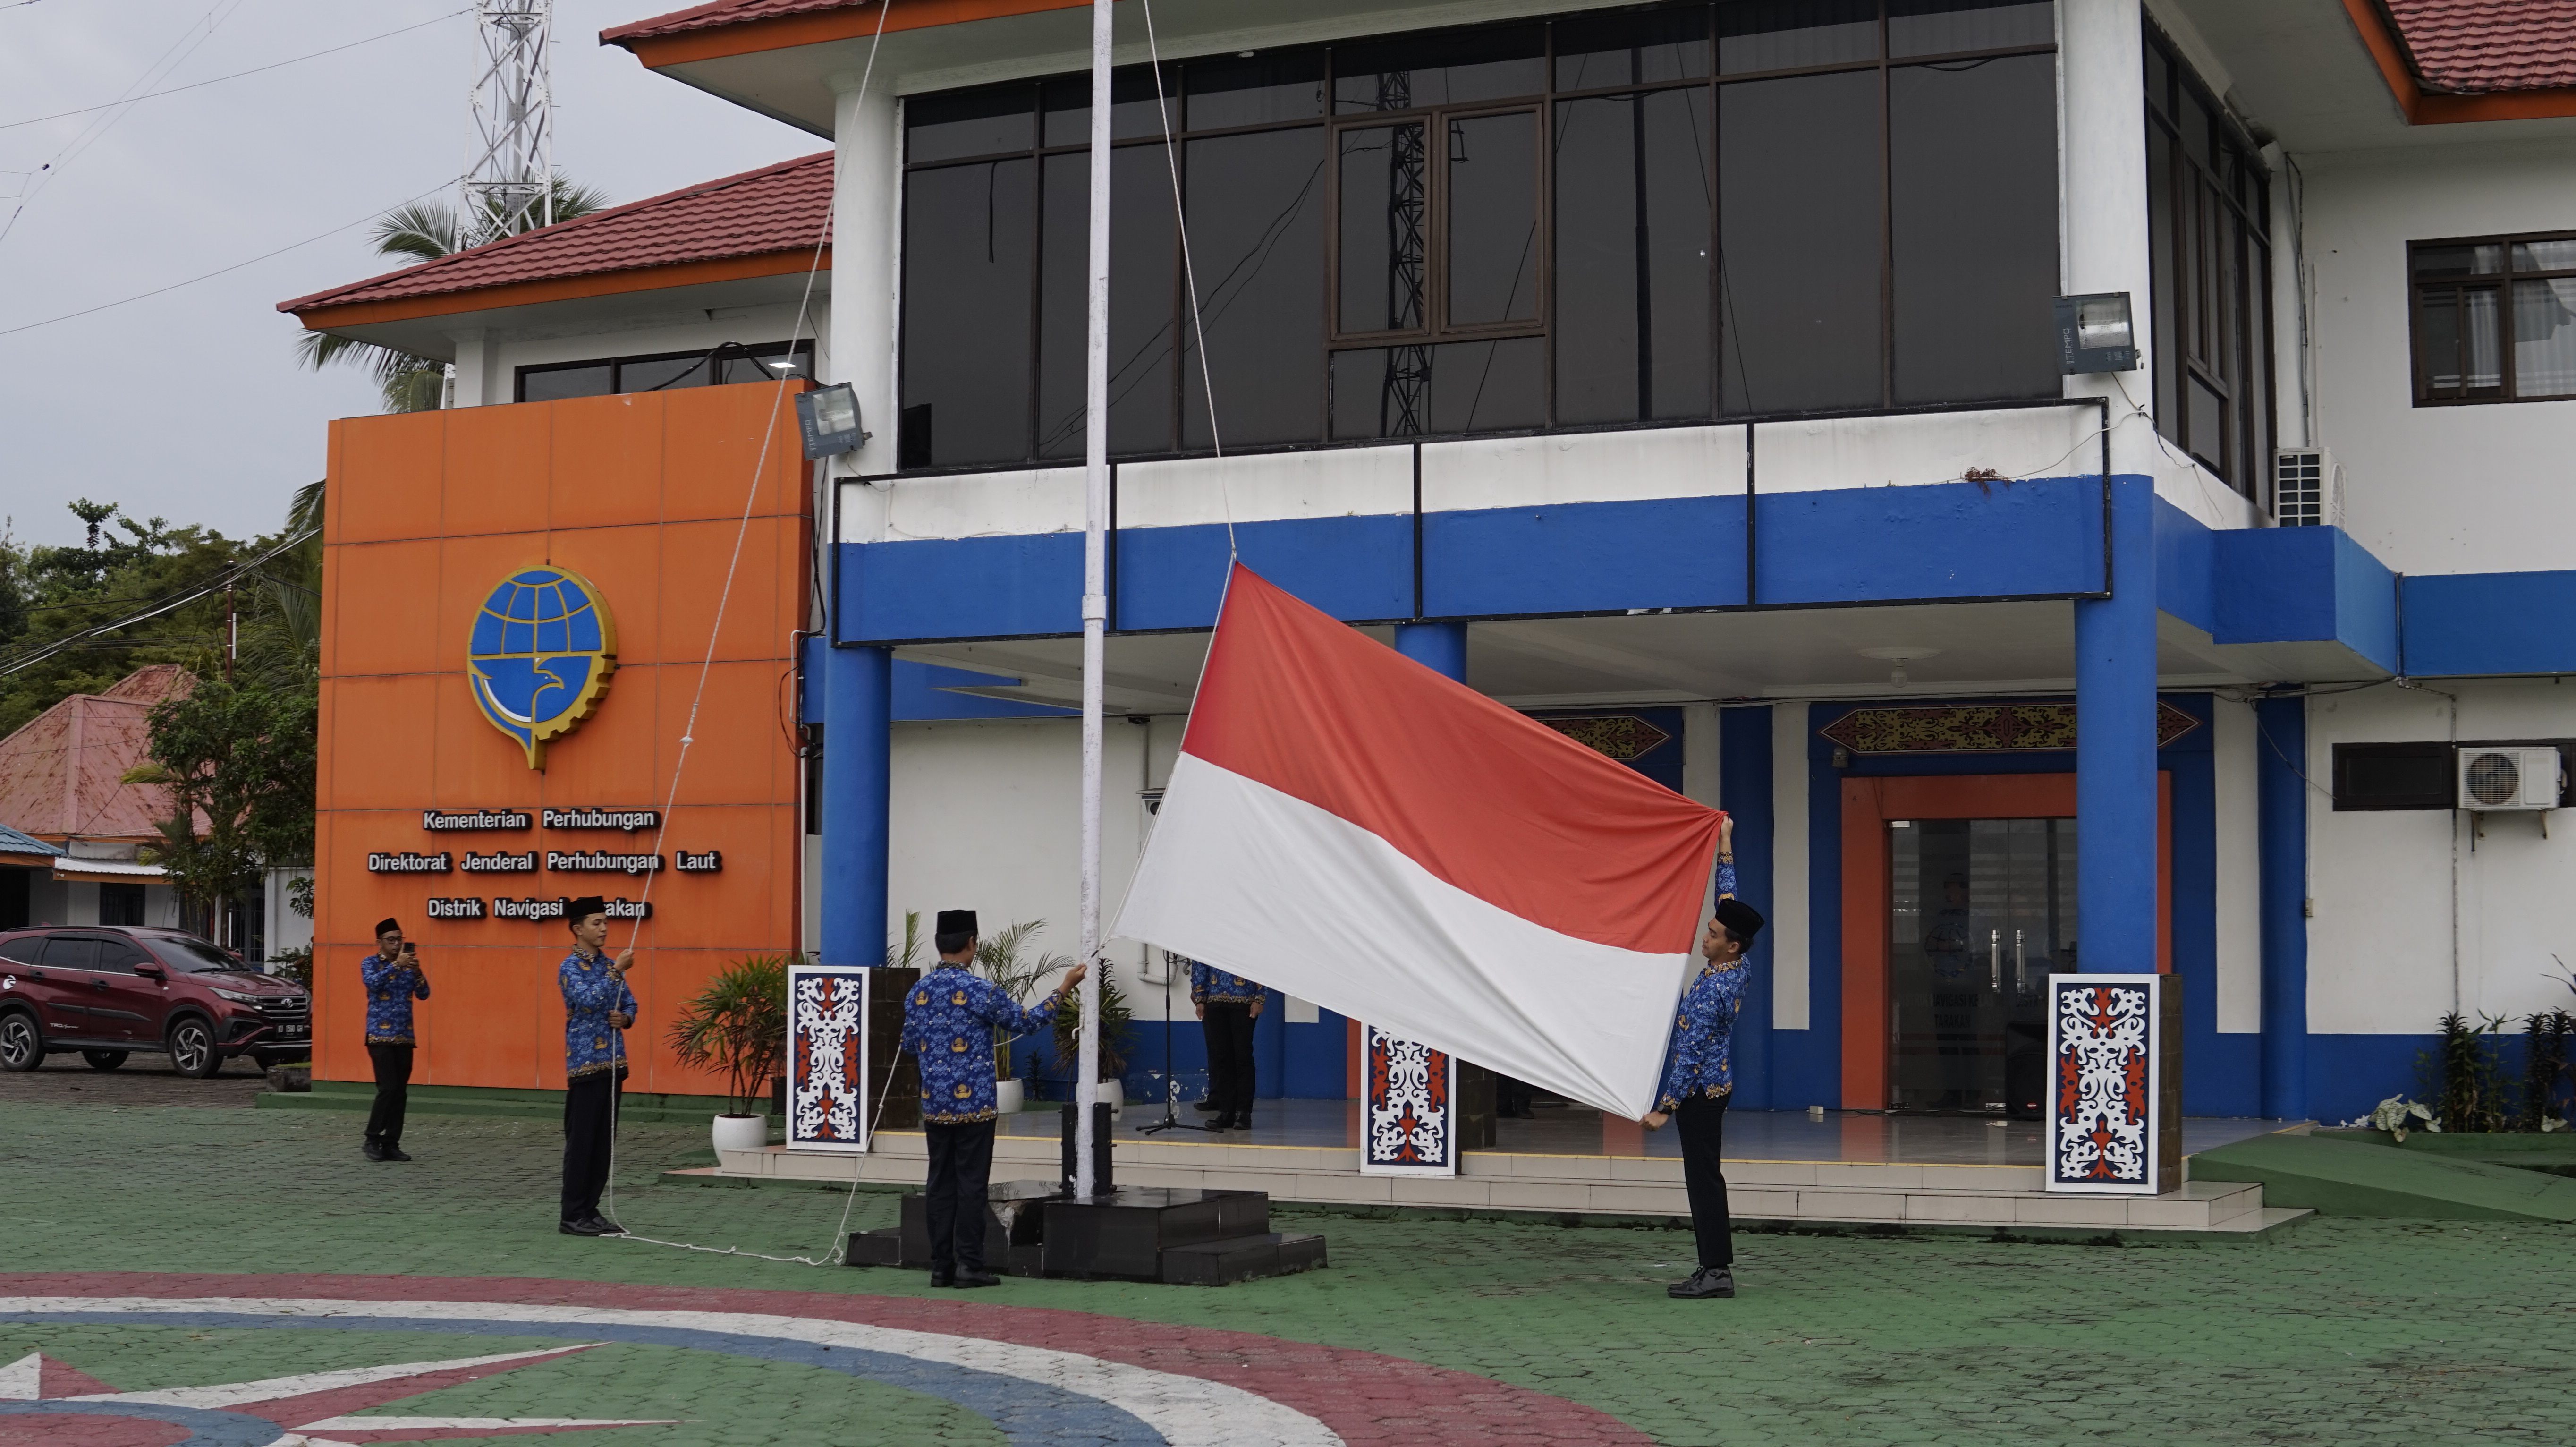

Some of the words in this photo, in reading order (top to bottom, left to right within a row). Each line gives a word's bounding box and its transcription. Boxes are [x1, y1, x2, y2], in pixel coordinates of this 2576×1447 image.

[2063, 328, 2072, 361] TEMPO
[424, 810, 526, 829] Kementerian
[543, 809, 654, 830] Perhubungan
[368, 853, 447, 871] Direktorat
[461, 852, 532, 870] Jenderal
[547, 851, 659, 874] Perhubungan
[677, 852, 716, 870] Laut
[428, 899, 481, 917] Distrik
[494, 898, 563, 920] Navigasi
[604, 899, 645, 916] akan
[1934, 1014, 1971, 1028] TARAKAN
